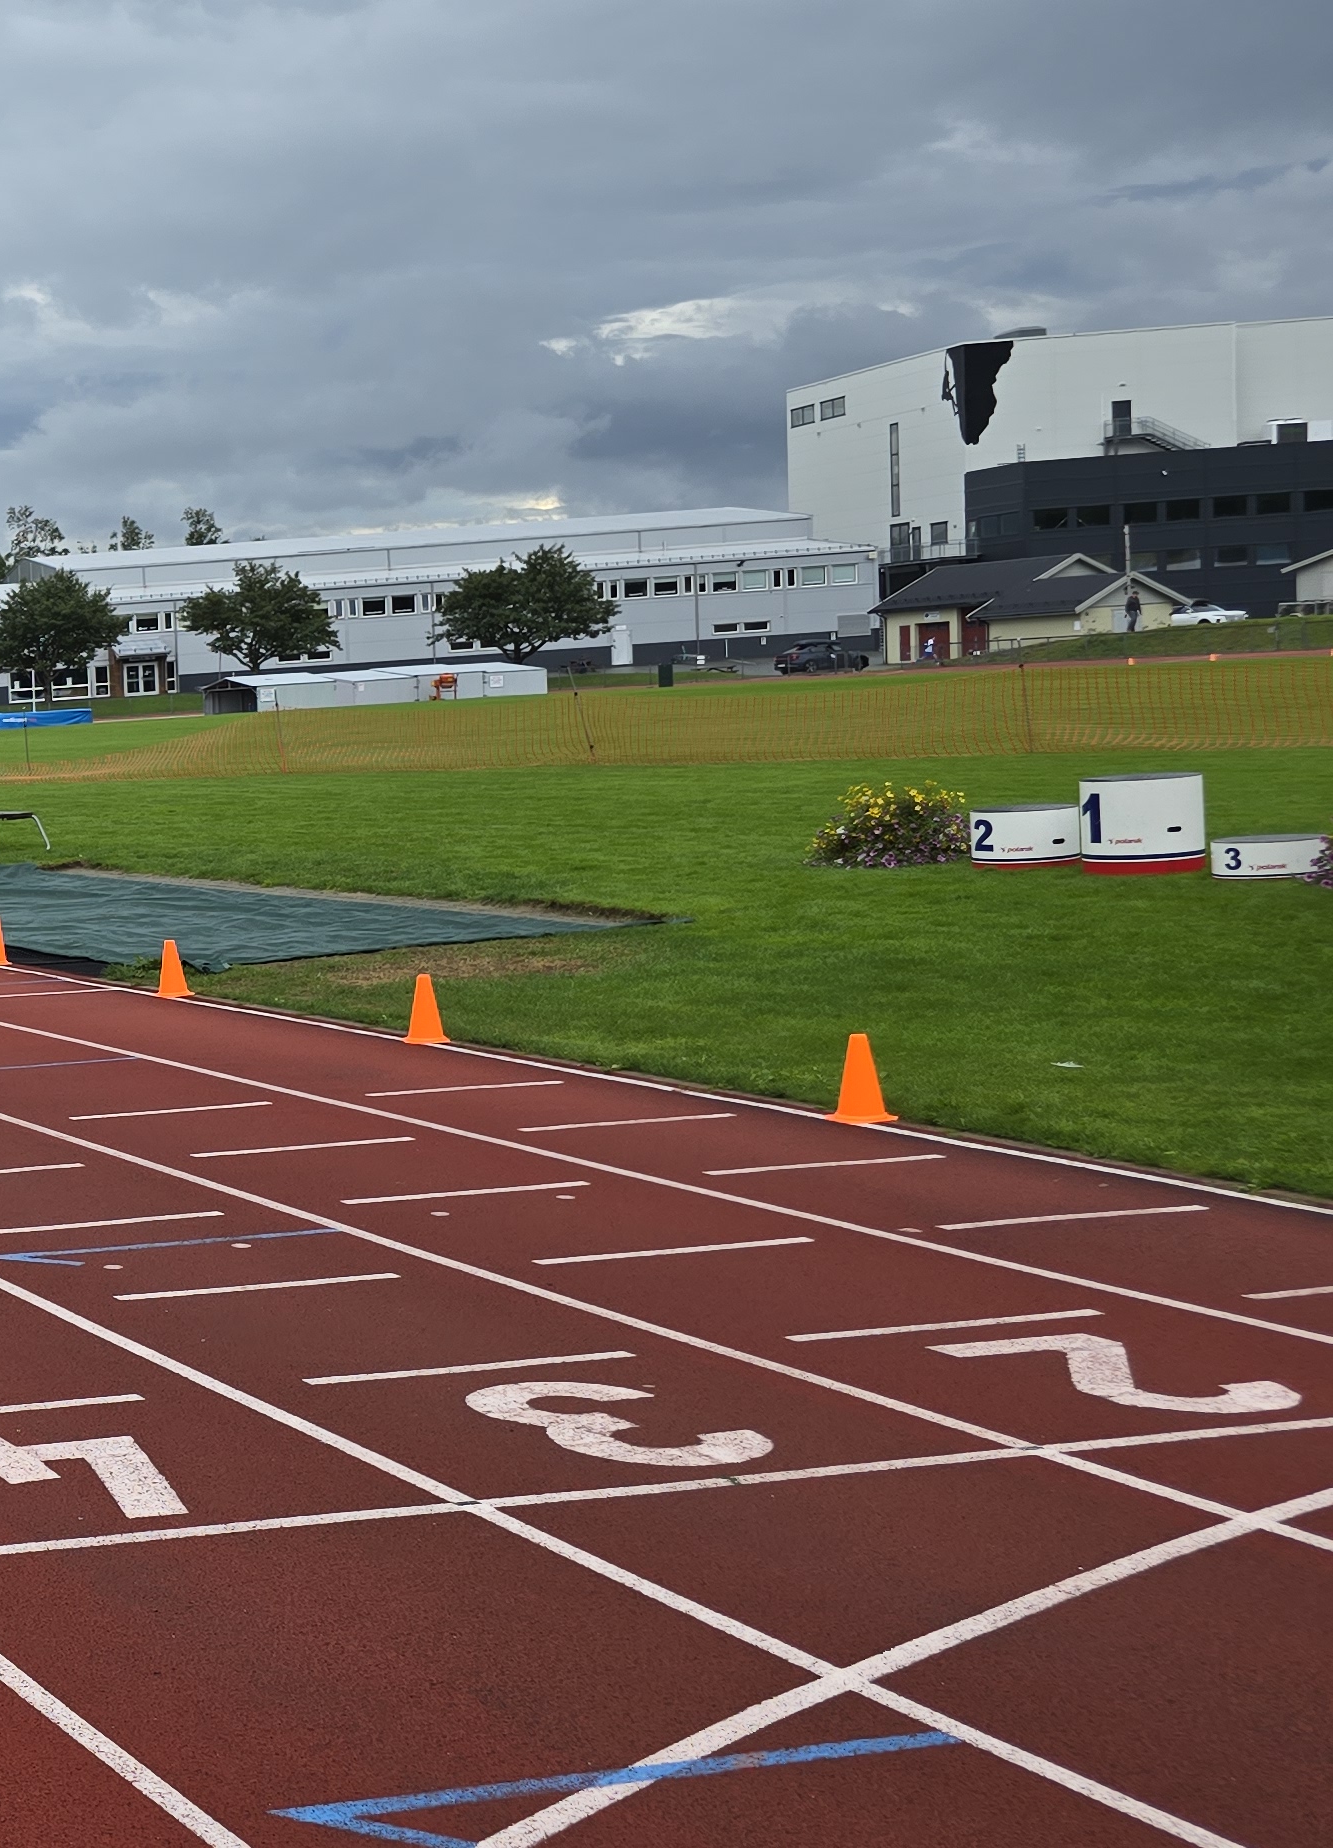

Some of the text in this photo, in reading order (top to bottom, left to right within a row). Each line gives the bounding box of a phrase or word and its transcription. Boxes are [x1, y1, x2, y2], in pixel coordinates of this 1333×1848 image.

[974, 819, 994, 852] 2
[1082, 793, 1102, 844] 1
[1224, 847, 1242, 870] 3
[925, 1333, 1302, 1414] 2
[465, 1381, 774, 1467] 3
